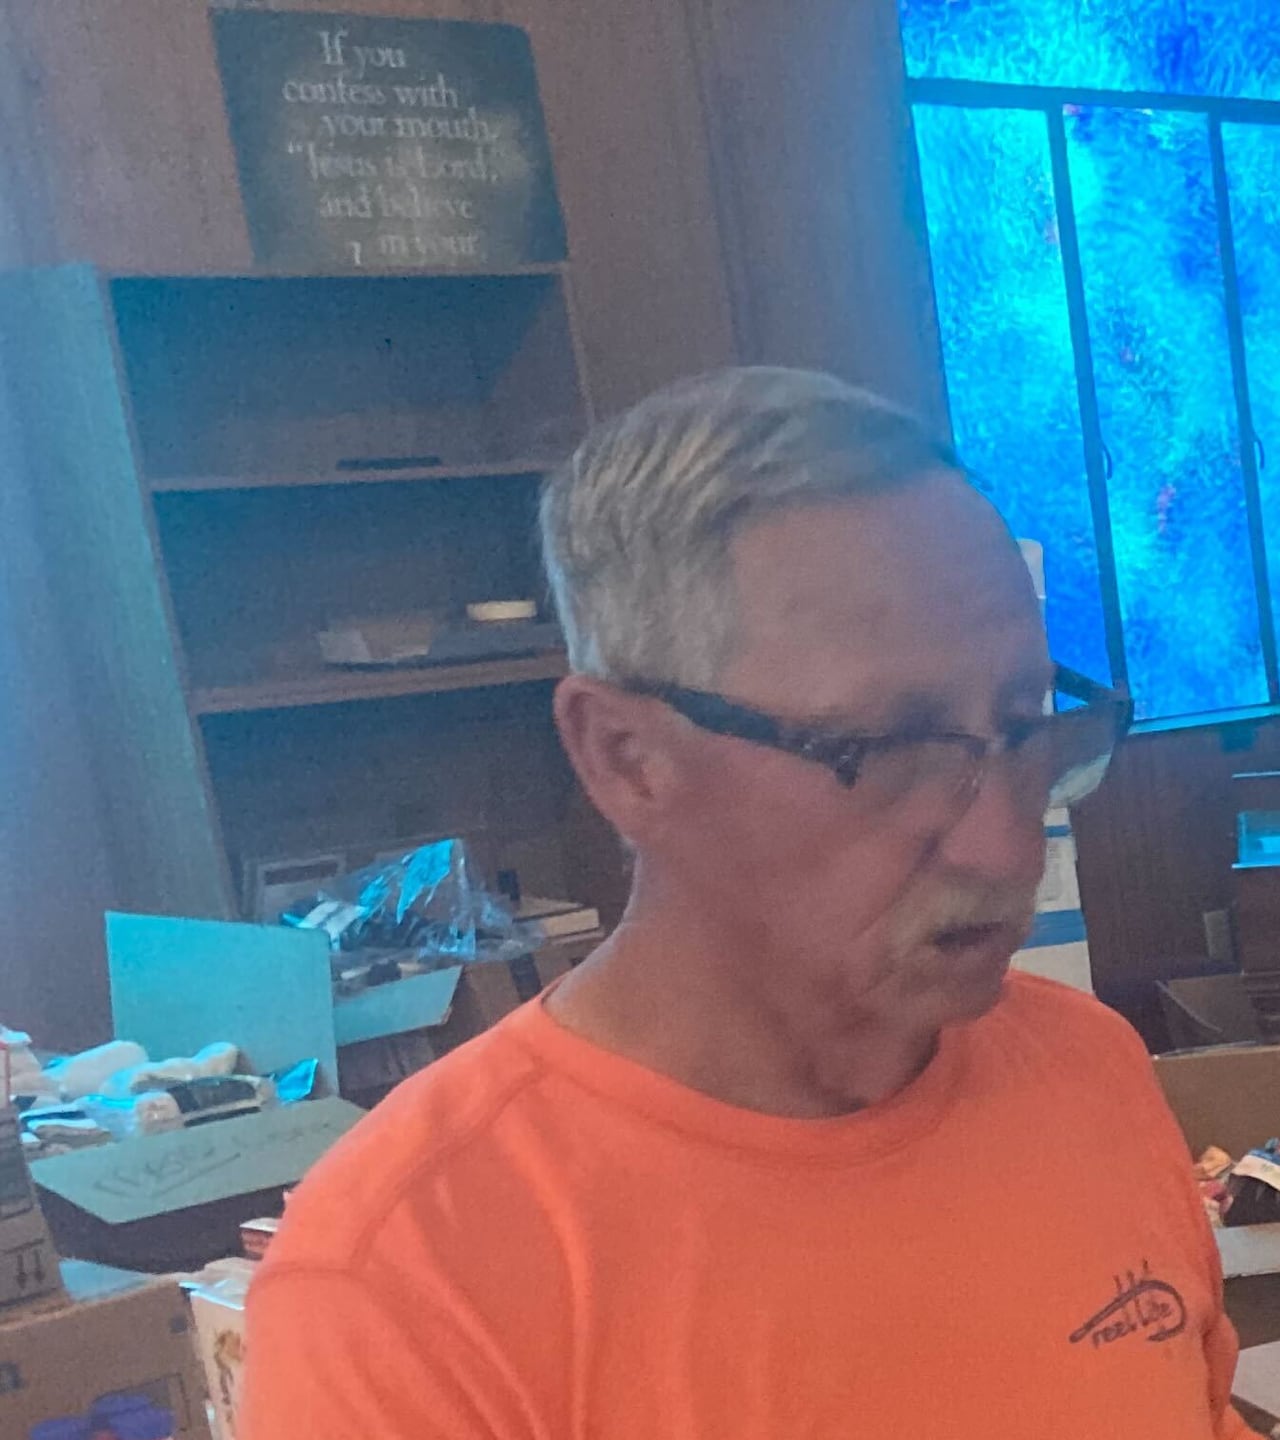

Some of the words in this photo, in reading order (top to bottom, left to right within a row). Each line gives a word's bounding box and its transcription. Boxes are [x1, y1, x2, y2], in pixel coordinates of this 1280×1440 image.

[318, 29, 349, 66] If
[351, 46, 407, 80] you
[281, 74, 386, 104] confess
[393, 72, 460, 109] with
[320, 114, 388, 139] your
[319, 184, 373, 219] and
[375, 179, 474, 220] believe
